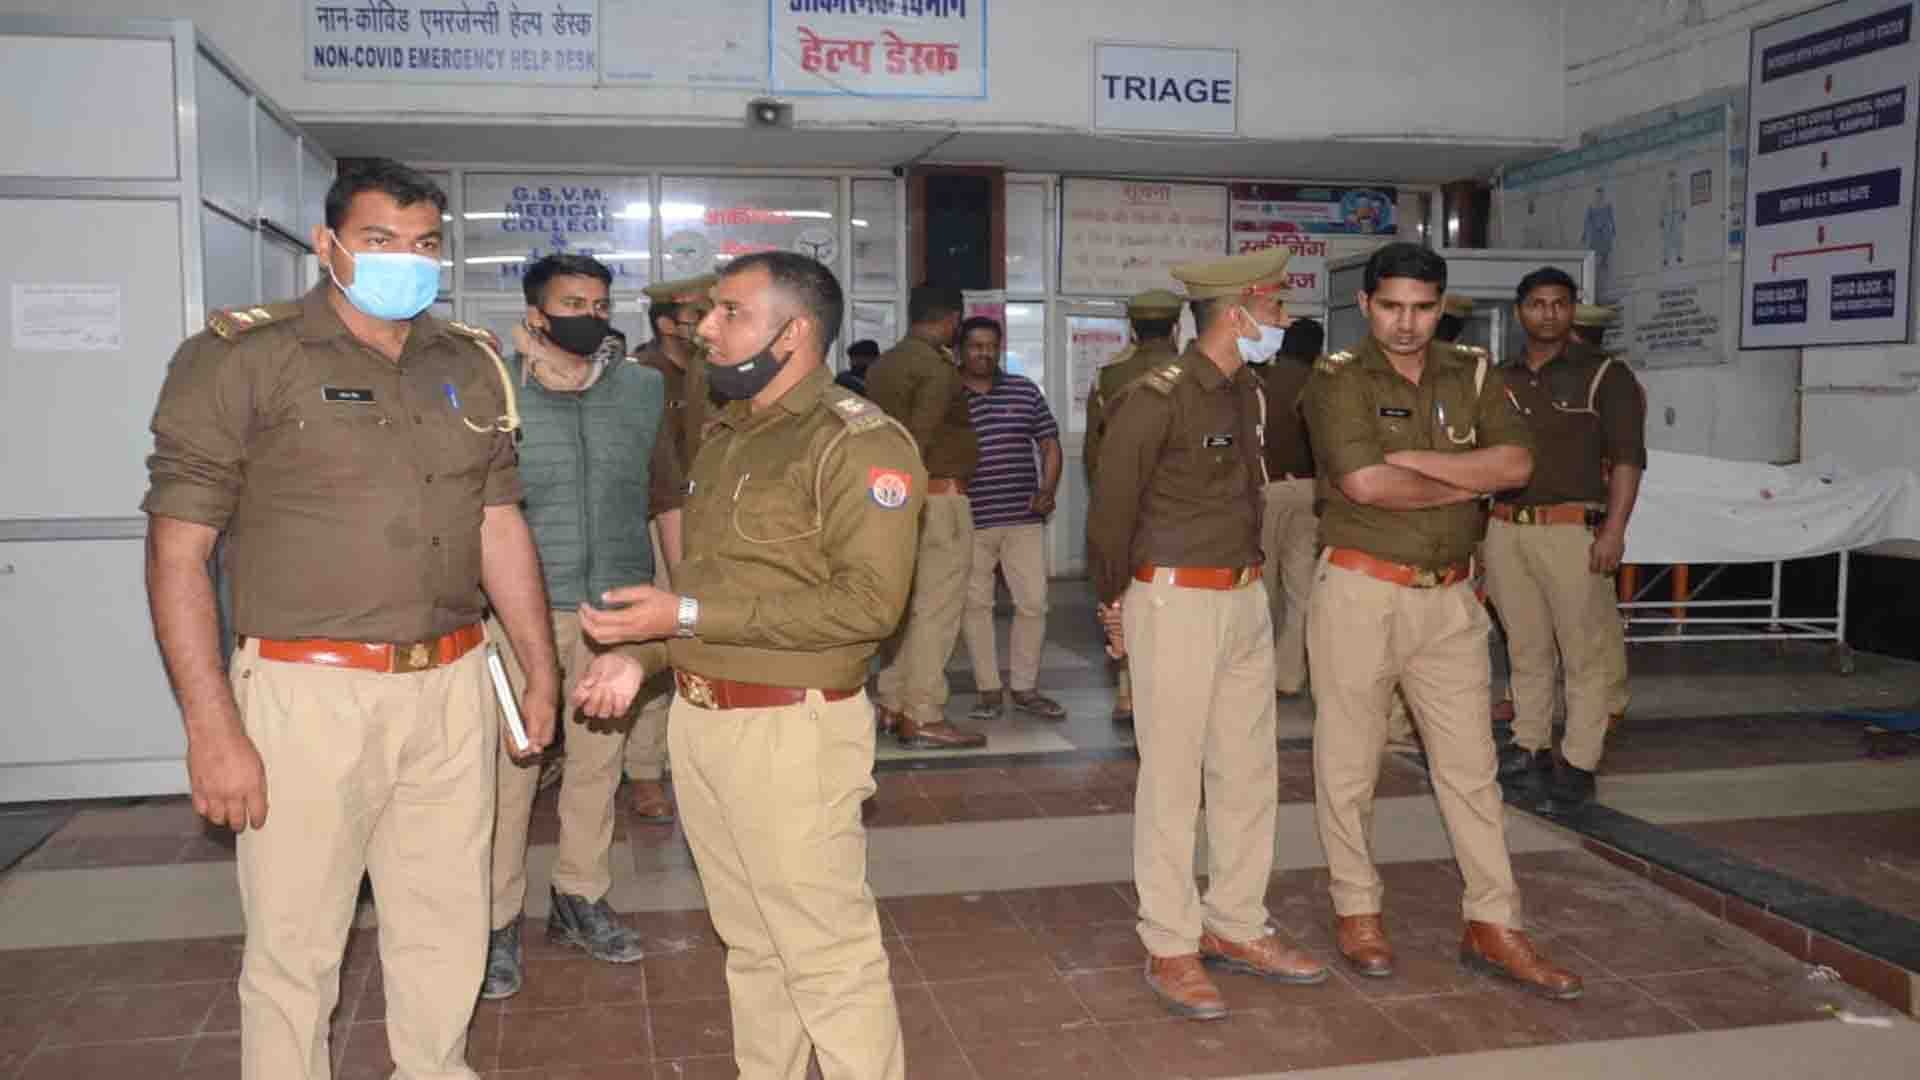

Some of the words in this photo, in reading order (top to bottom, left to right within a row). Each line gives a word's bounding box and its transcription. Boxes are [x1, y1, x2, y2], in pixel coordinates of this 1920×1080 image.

[313, 45, 403, 67] NON-COVID
[408, 47, 504, 70] EMERGENCY
[798, 26, 875, 73] हेल्प
[883, 29, 960, 74] डेस्क
[1102, 74, 1232, 104] TRIAGE
